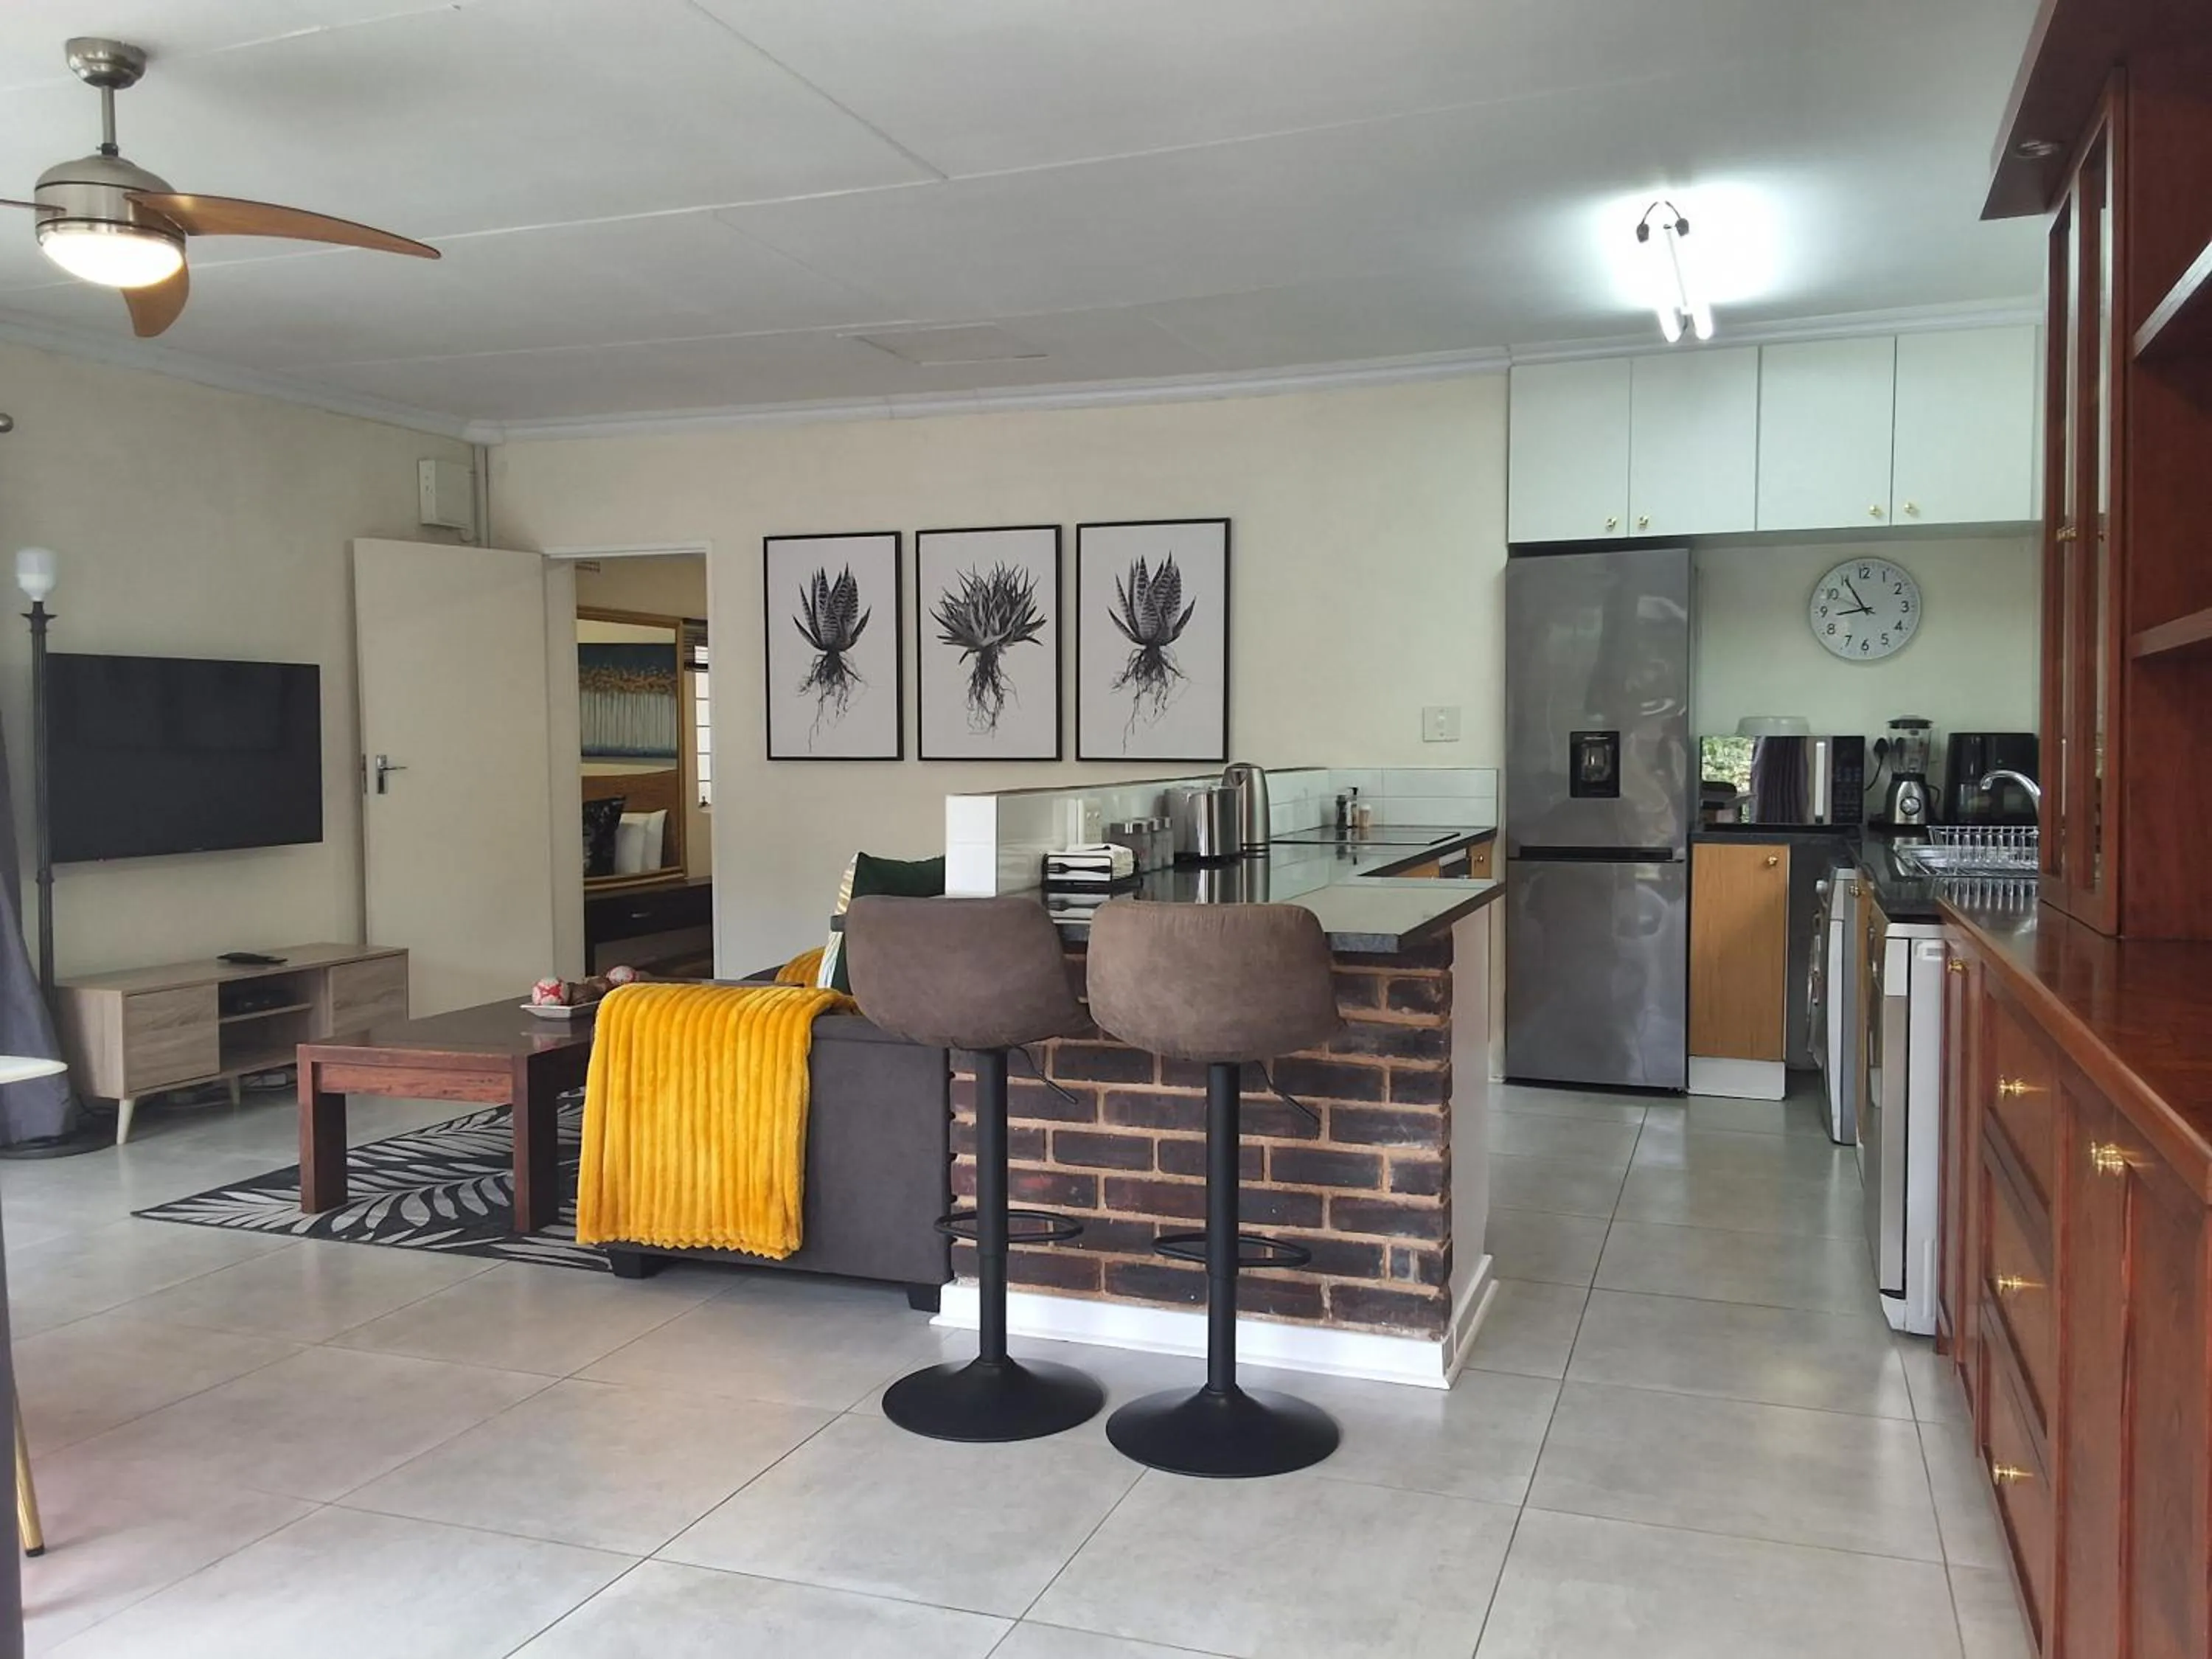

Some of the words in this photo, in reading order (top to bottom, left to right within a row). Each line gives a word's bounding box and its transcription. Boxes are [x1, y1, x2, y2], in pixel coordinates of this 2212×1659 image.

[1859, 567, 1871, 579] 12
[1827, 588, 1839, 600] 10
[1893, 582, 1902, 594] 2
[1820, 606, 1828, 617] 9
[1901, 601, 1909, 613] 3
[1827, 624, 1835, 634] 8
[1893, 620, 1902, 630] 4
[1844, 635, 1852, 647] 7
[1861, 639, 1869, 650] 6
[1881, 633, 1888, 645] 5
